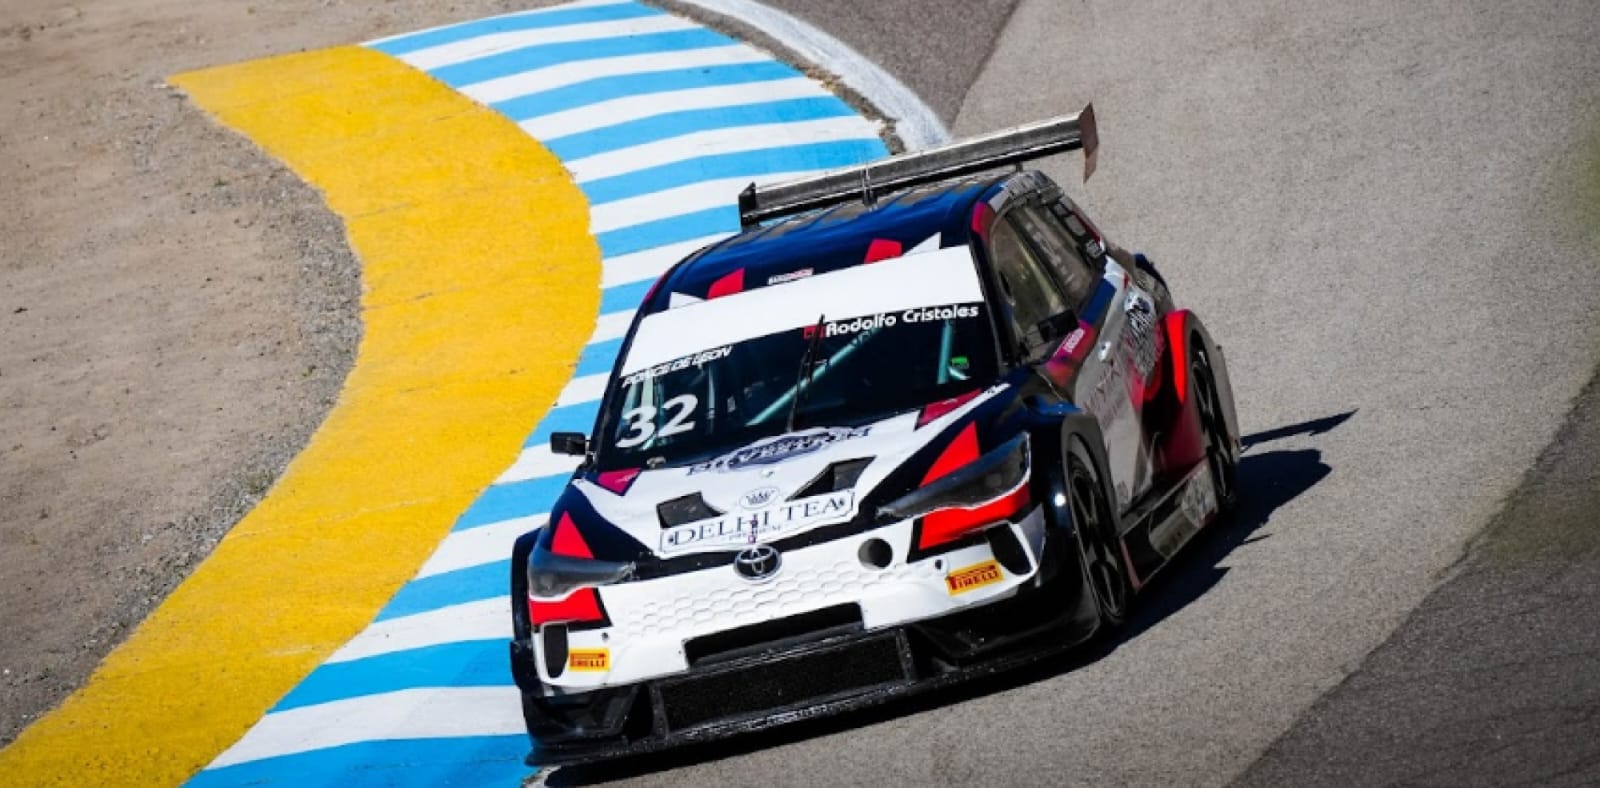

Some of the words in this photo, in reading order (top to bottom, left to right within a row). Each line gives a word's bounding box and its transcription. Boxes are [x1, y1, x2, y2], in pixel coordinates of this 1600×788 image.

[826, 313, 896, 337] Rodolfo
[902, 304, 979, 323] Cristales
[615, 394, 698, 448] 32
[674, 511, 769, 545] DELHI
[781, 497, 840, 520] TEA
[949, 564, 1000, 590] PIRELLI
[570, 652, 605, 668] PIRELLI
